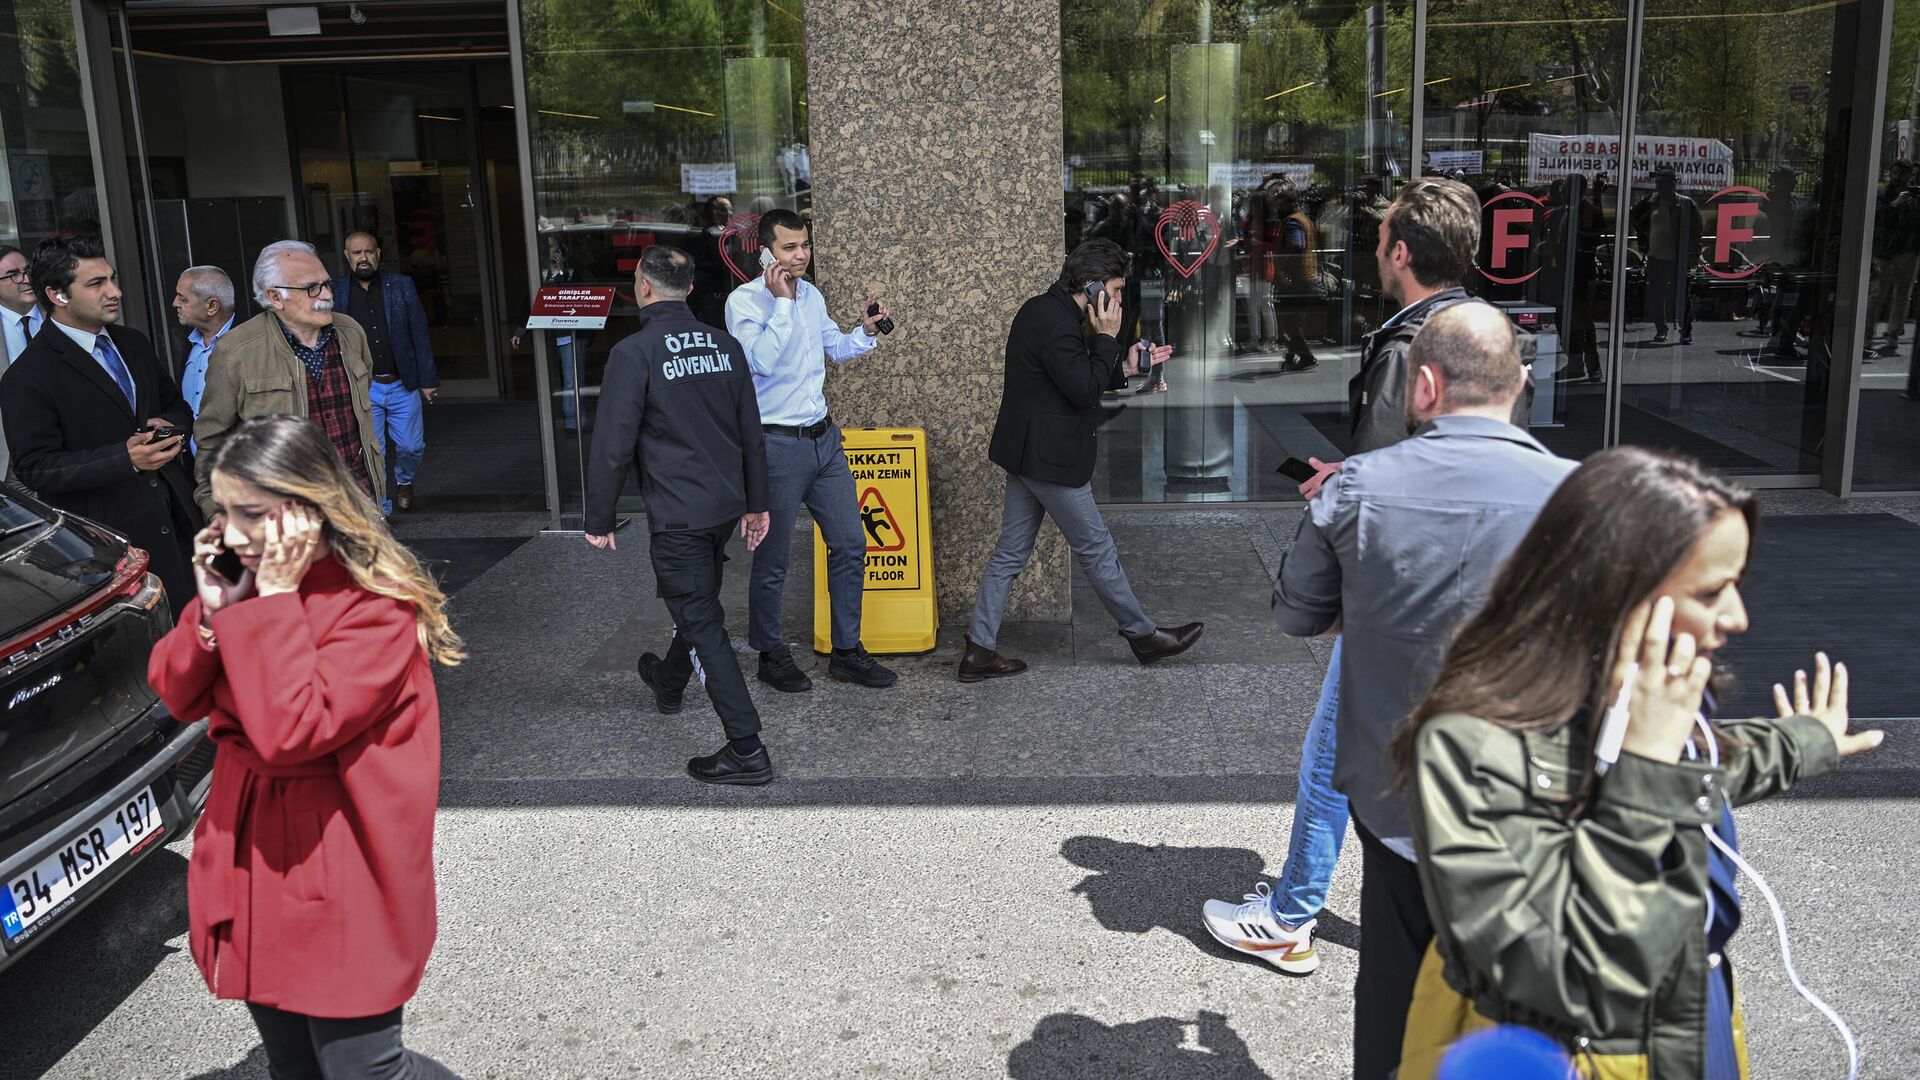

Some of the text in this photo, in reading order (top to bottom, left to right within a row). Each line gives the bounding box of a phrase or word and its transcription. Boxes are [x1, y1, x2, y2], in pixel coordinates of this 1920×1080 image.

[664, 331, 718, 353] ÖZEL
[662, 350, 732, 380] GÜVENLİK
[850, 469, 875, 480] GAN
[864, 555, 908, 567] UTION
[869, 570, 905, 581] FLOOR
[9, 613, 94, 666] SCHE
[13, 790, 152, 918] 34 MSR 197
[3, 911, 19, 927] TR
